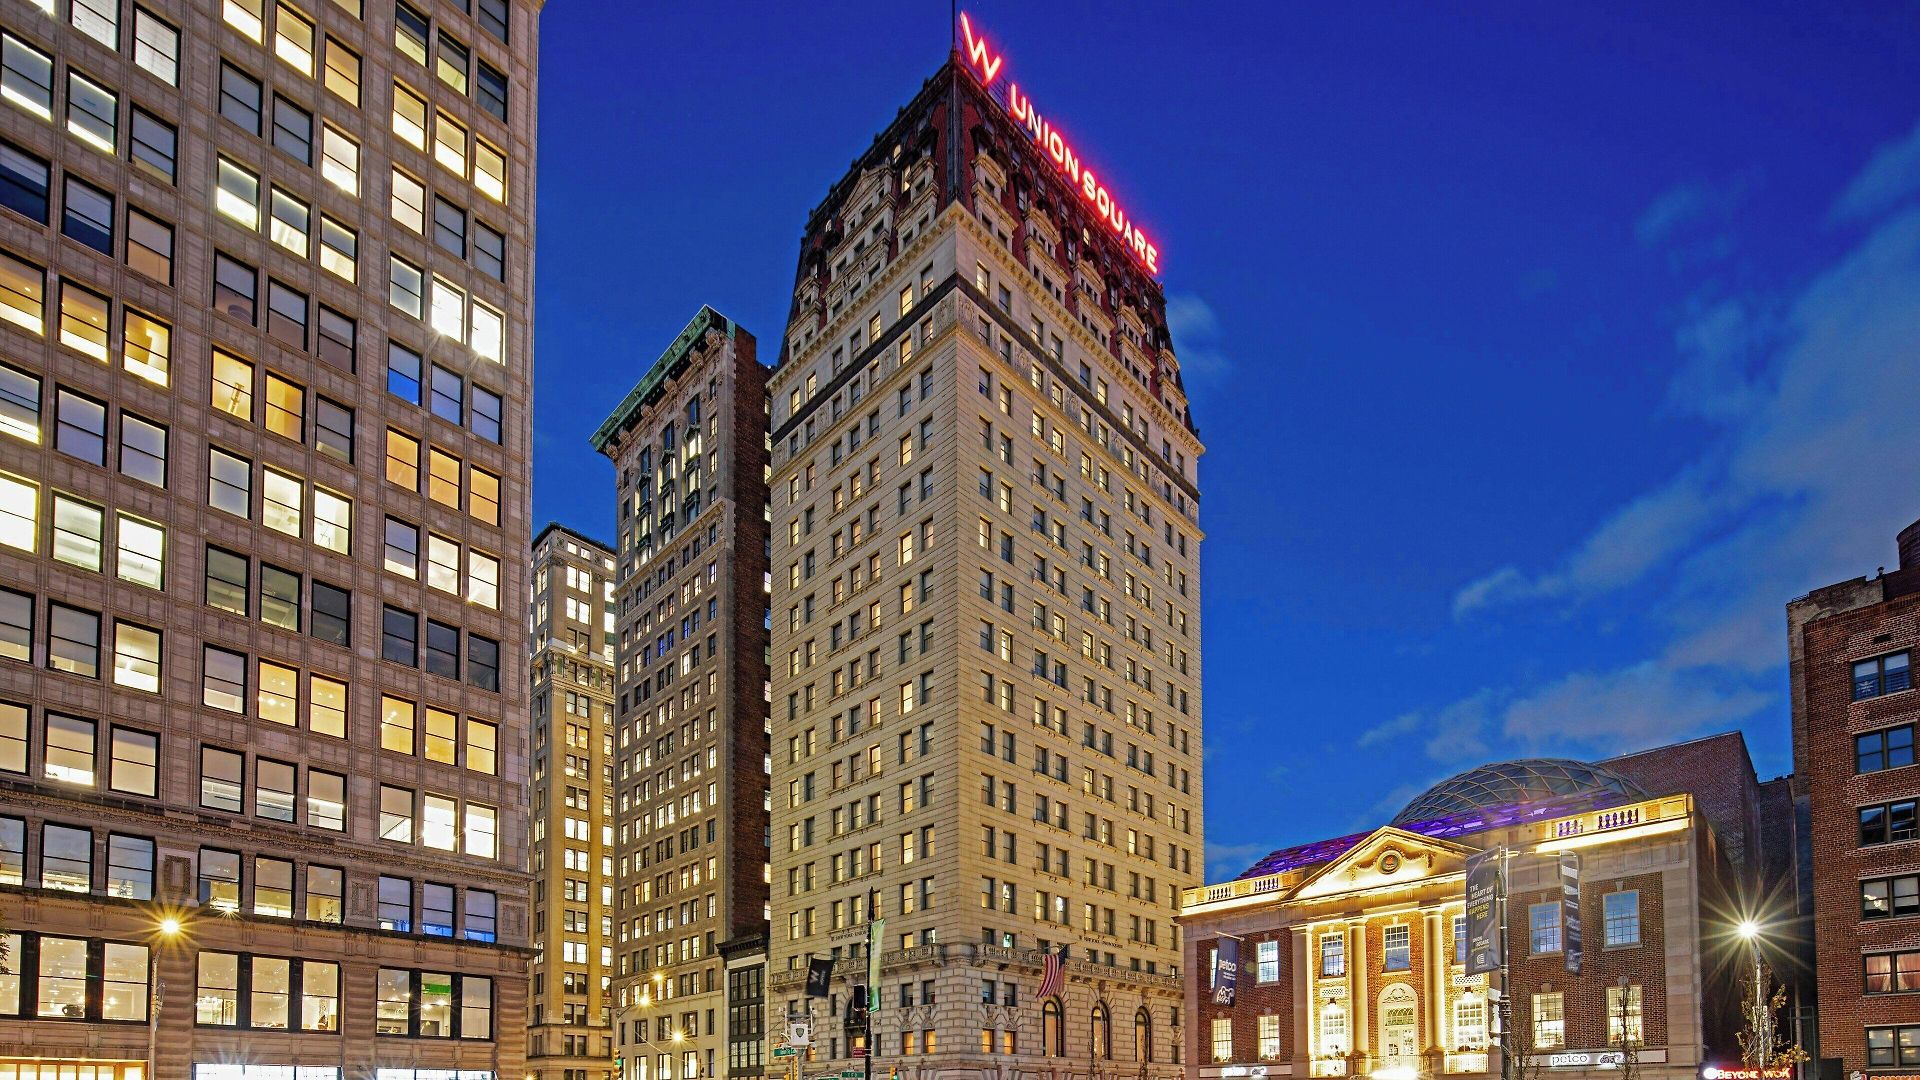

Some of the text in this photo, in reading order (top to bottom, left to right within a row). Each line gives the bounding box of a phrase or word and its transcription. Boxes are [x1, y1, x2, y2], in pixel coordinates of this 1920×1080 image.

[960, 11, 1159, 275] W UNION SQUARE
[1470, 884, 1479, 892] THE
[1471, 888, 1486, 900] HEART
[1467, 894, 1494, 909] EVERYTHING
[1477, 911, 1489, 921] HERE
[1218, 959, 1237, 972] petco
[1552, 1054, 1588, 1066] petco
